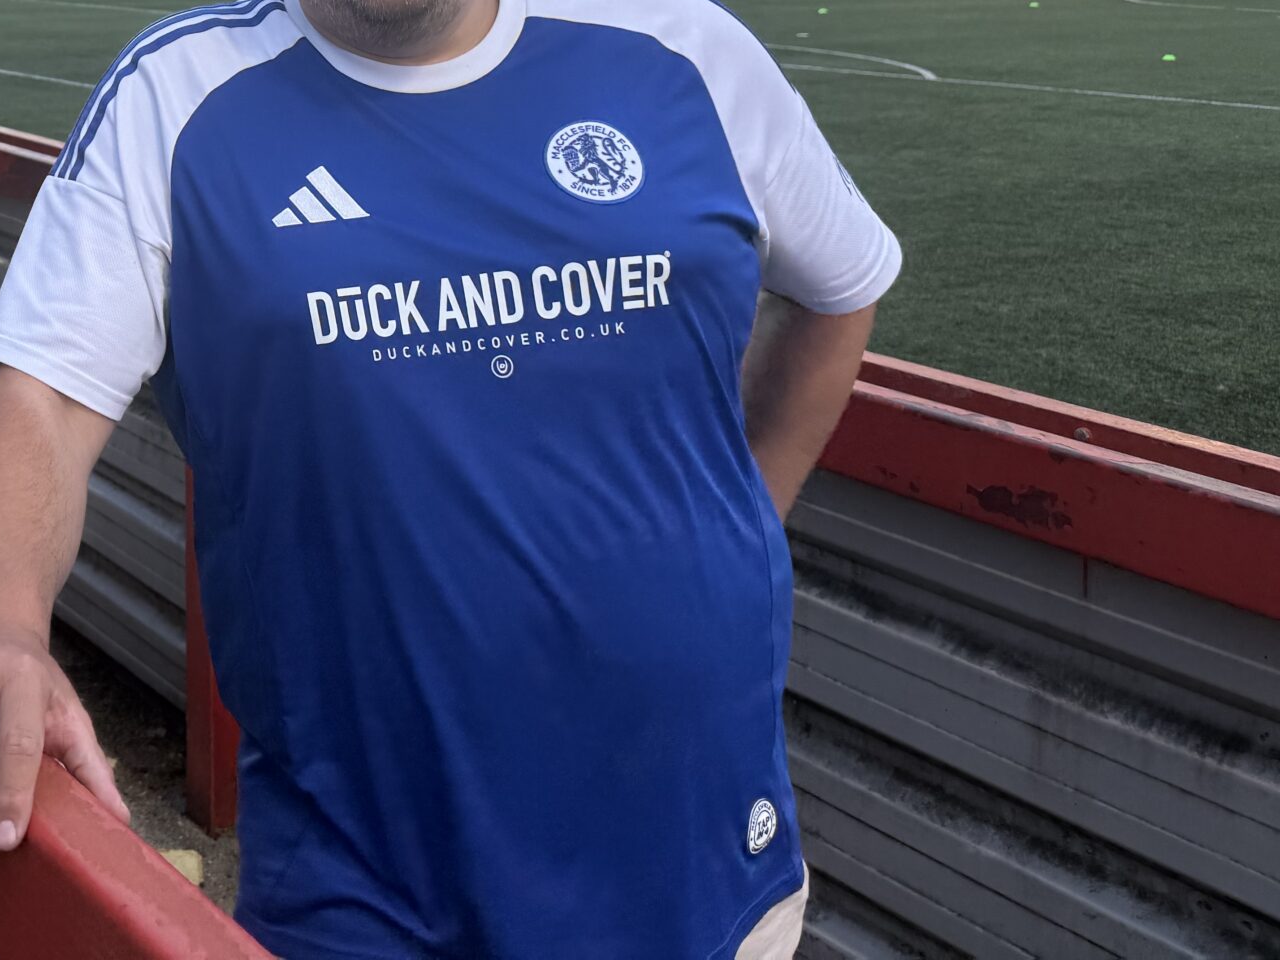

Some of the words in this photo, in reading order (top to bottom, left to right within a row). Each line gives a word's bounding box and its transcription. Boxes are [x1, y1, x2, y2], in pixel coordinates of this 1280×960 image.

[551, 125, 617, 160] MACCLESFIELD
[616, 138, 631, 152] FC
[570, 181, 606, 197] SINCE
[618, 174, 637, 192] 1874
[437, 270, 524, 332] AND
[531, 253, 671, 320] COVER
